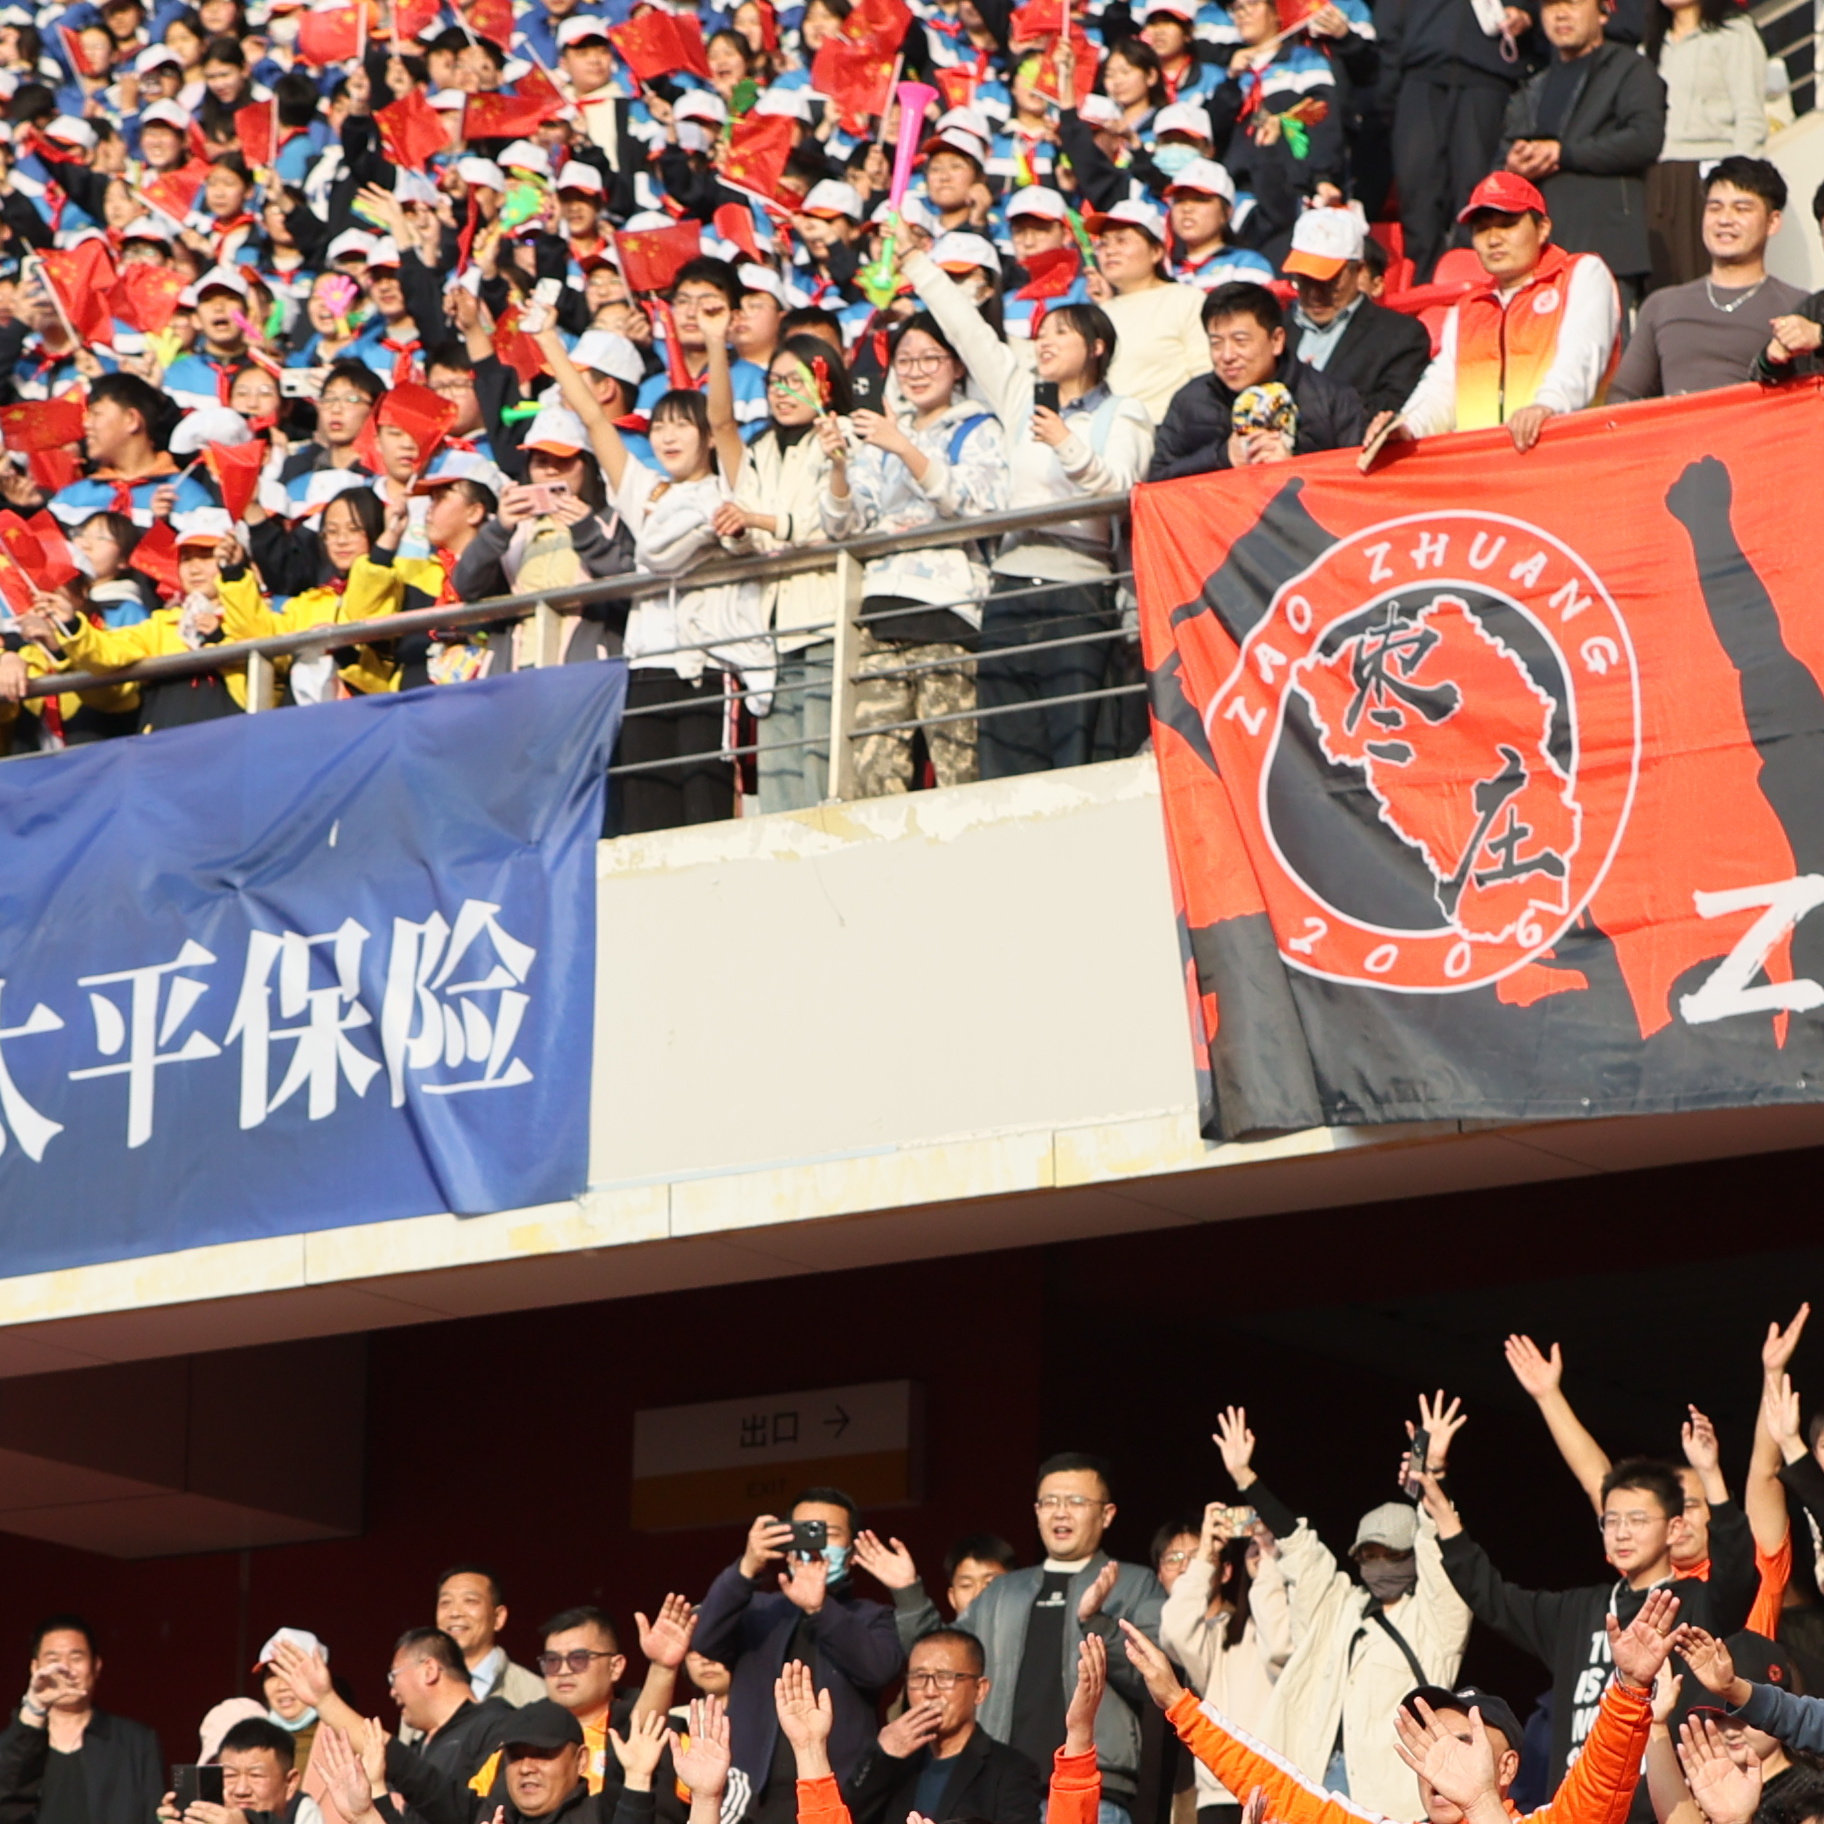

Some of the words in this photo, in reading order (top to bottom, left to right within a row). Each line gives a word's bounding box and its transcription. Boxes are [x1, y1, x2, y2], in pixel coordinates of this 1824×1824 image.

[1363, 530, 1621, 676] ZHUANG
[1226, 592, 1314, 737] ZAO
[1288, 915, 1545, 979] 2006
[740, 1410, 799, 1448] 出口
[747, 1480, 788, 1497] EXIT
